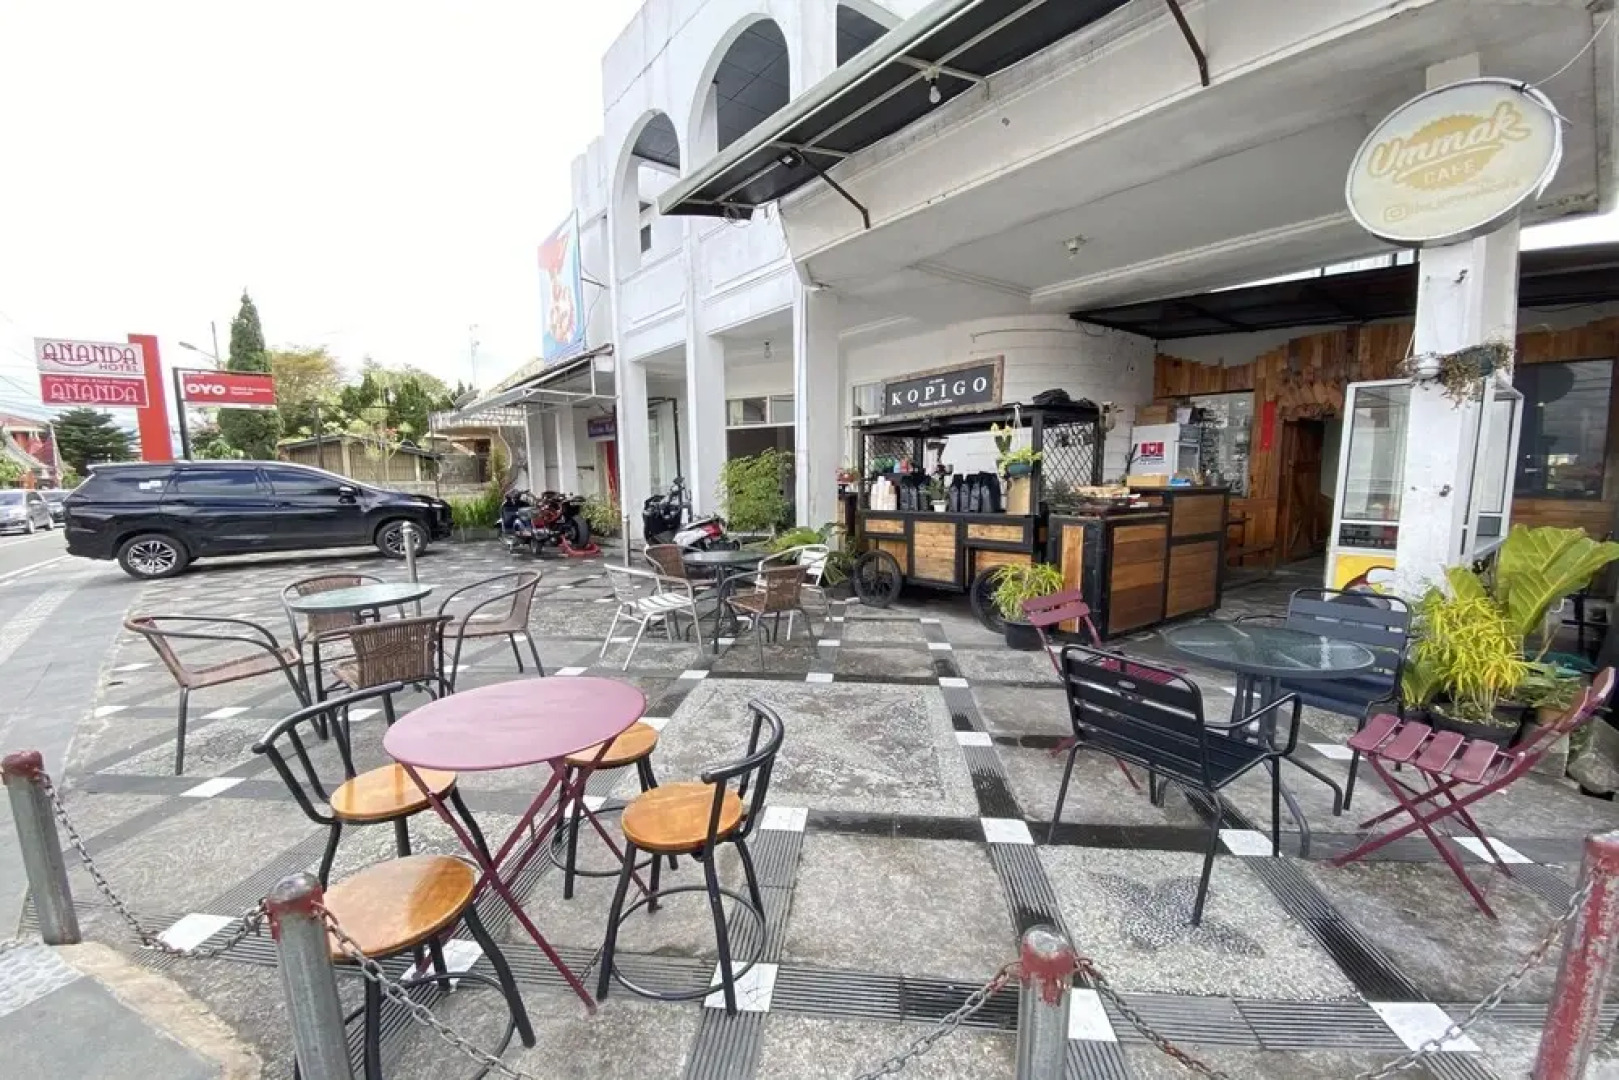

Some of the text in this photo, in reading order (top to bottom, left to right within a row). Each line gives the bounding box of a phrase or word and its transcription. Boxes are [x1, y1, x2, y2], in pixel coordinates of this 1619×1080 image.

[1368, 100, 1531, 180] Ummak
[1423, 158, 1478, 186] CAFE
[42, 342, 139, 366] ANANDA
[98, 364, 138, 373] HOTEL
[51, 383, 139, 402] ANANDA
[185, 383, 226, 396] OYO
[891, 376, 988, 406] KOPIGO
